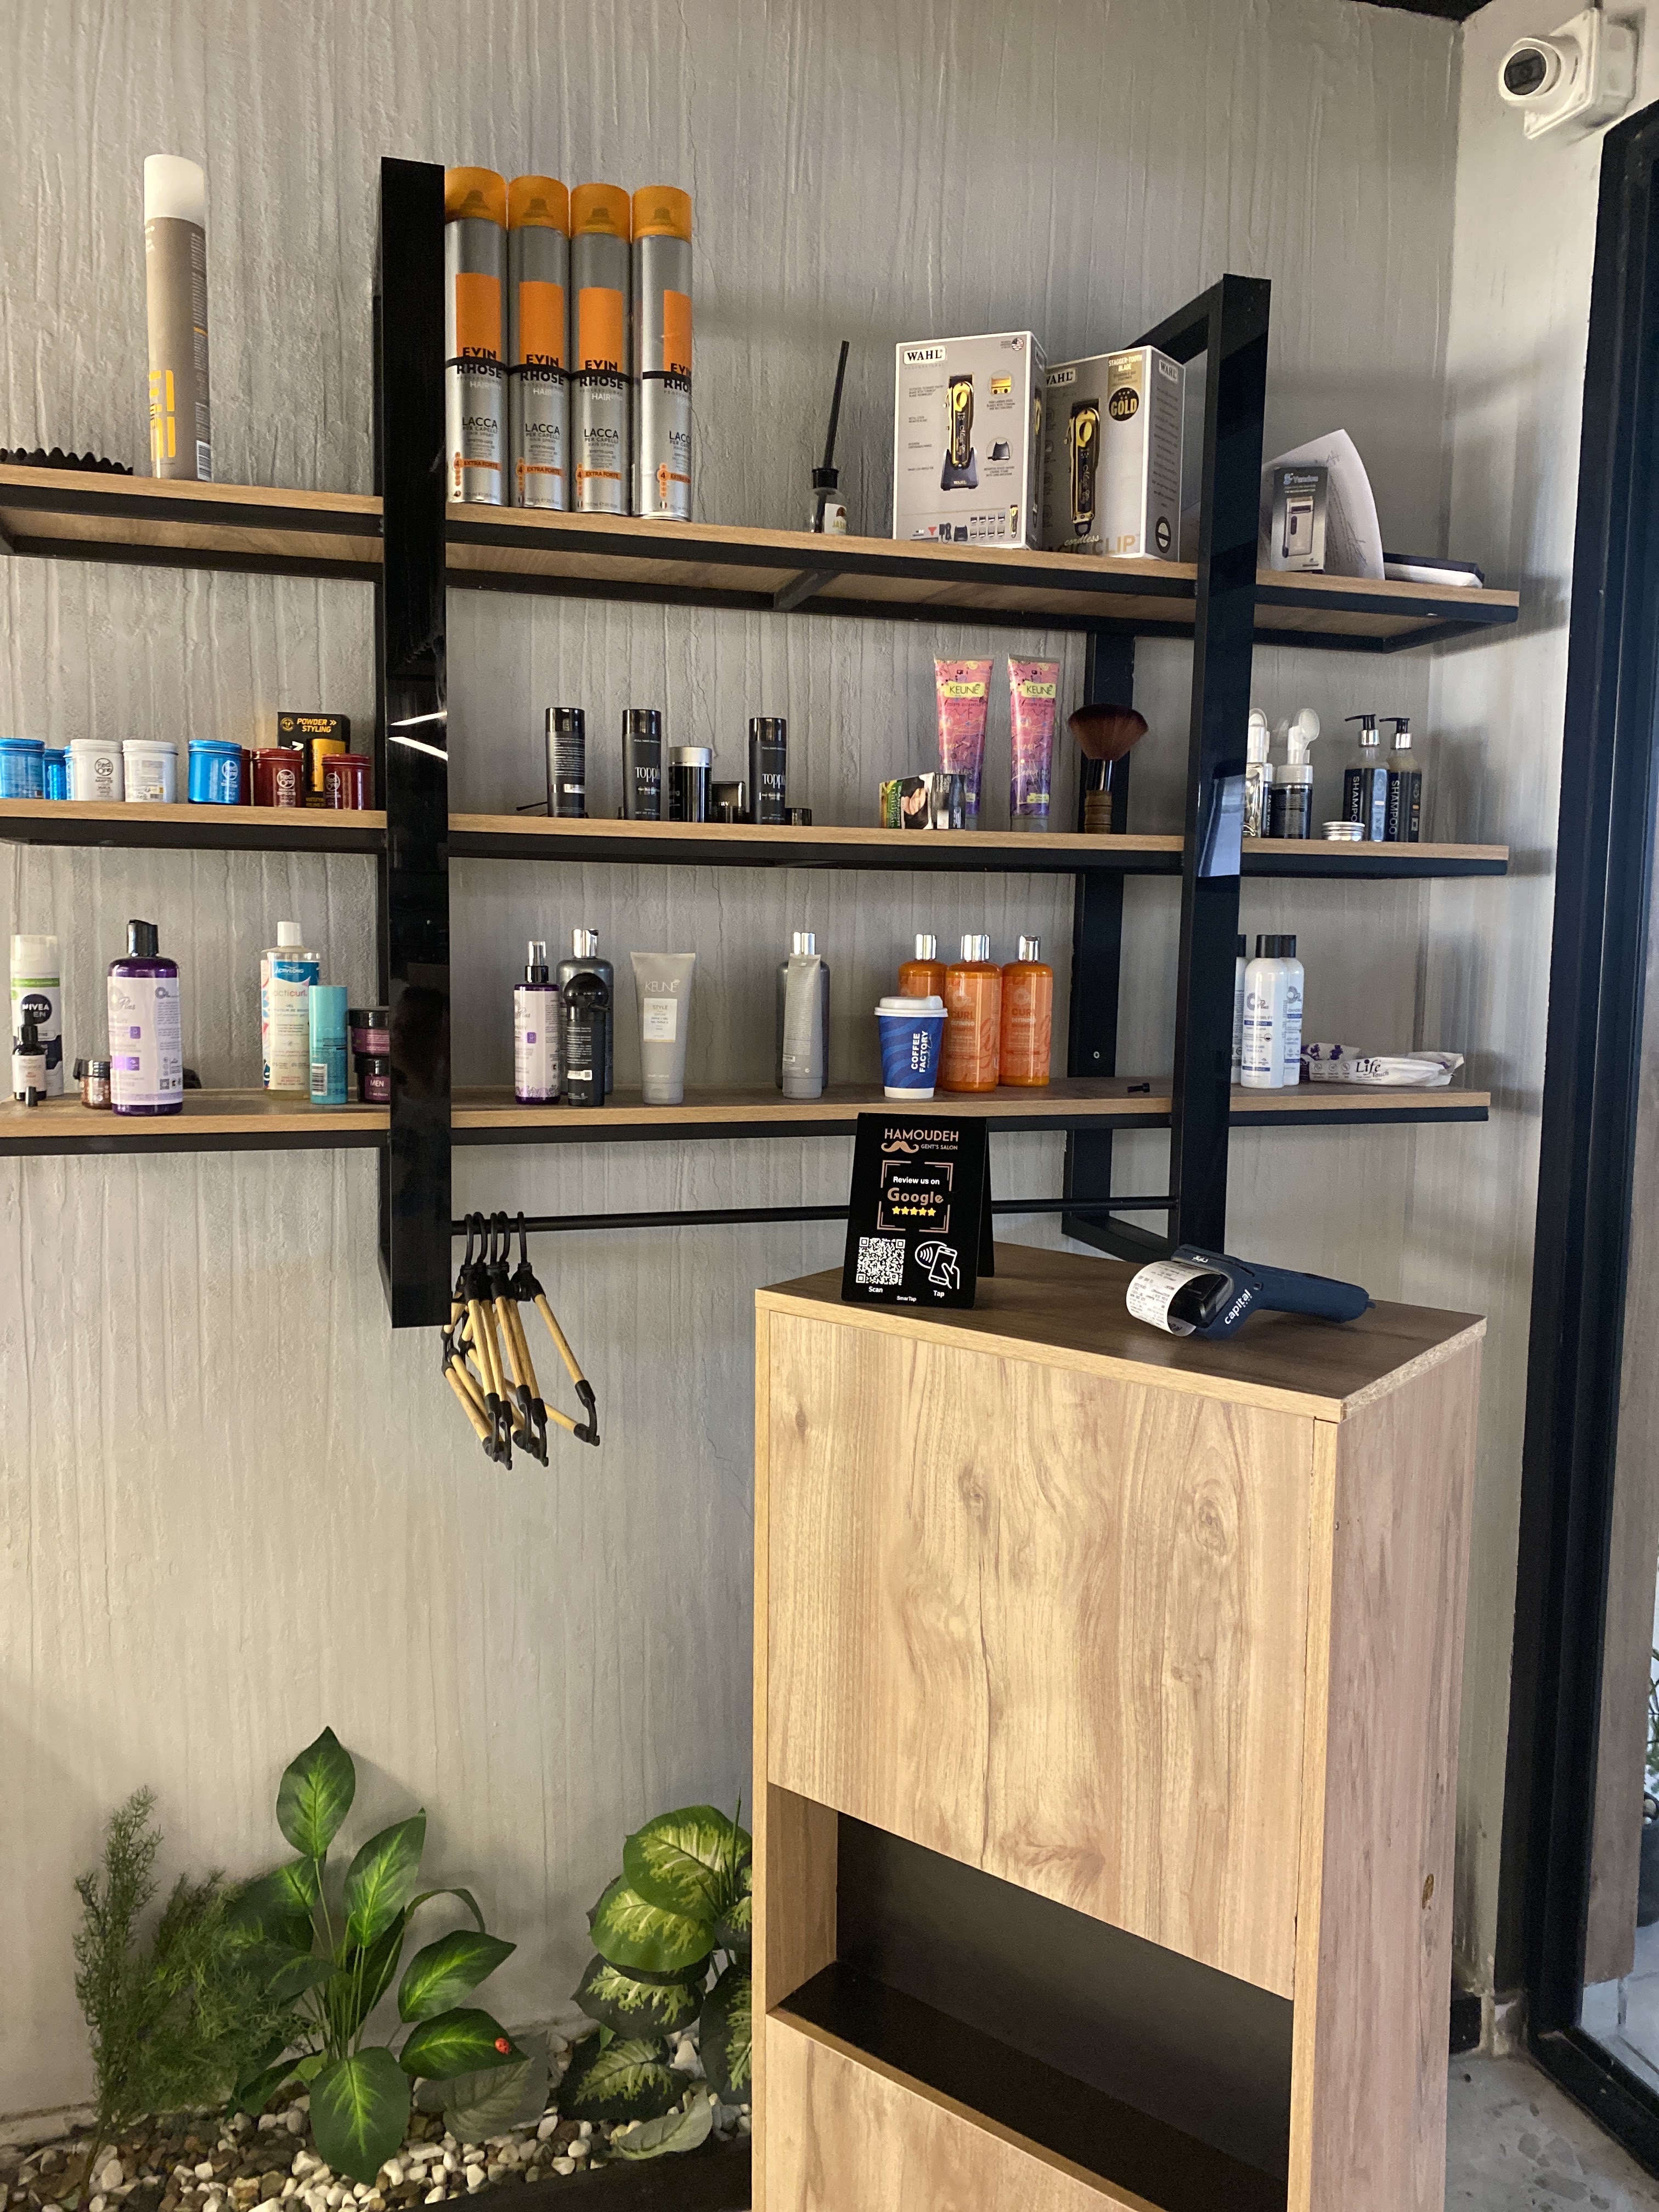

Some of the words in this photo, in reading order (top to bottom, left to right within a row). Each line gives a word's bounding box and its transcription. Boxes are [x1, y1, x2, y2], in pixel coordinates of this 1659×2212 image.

[462, 347, 496, 360] EVIN
[526, 354, 558, 366] EVIN
[907, 349, 943, 361] WAHL
[457, 364, 502, 379] RHOSE
[585, 360, 618, 371] EVIN
[1118, 363, 1132, 371] BLADE
[1160, 360, 1177, 380] WAHL
[520, 371, 564, 385] RHOSE
[579, 376, 623, 390] RHOSE
[1110, 398, 1137, 416] GOLD
[462, 417, 498, 428] LACCA
[525, 423, 560, 435] LACCA
[584, 428, 619, 439] LACCA
[669, 431, 691, 444] LACC
[1064, 533, 1101, 546] cordless
[949, 685, 979, 695] KEUNE
[1026, 685, 1052, 696] KEUNE
[297, 718, 328, 726] POWDER
[1350, 776, 1360, 823] SHAMPO
[1388, 780, 1400, 836] SHAMPOO
[952, 1011, 975, 1020] CURL
[1012, 1008, 1035, 1016] CUR
[911, 1033, 921, 1070] COFFEE
[919, 1030, 929, 1073] FACTORY
[1356, 1059, 1381, 1076] Life
[884, 1128, 959, 1142] HAMOUDEH
[893, 1176, 918, 1184] Review
[887, 1187, 944, 1206] Google
[1224, 1289, 1251, 1325] capital
